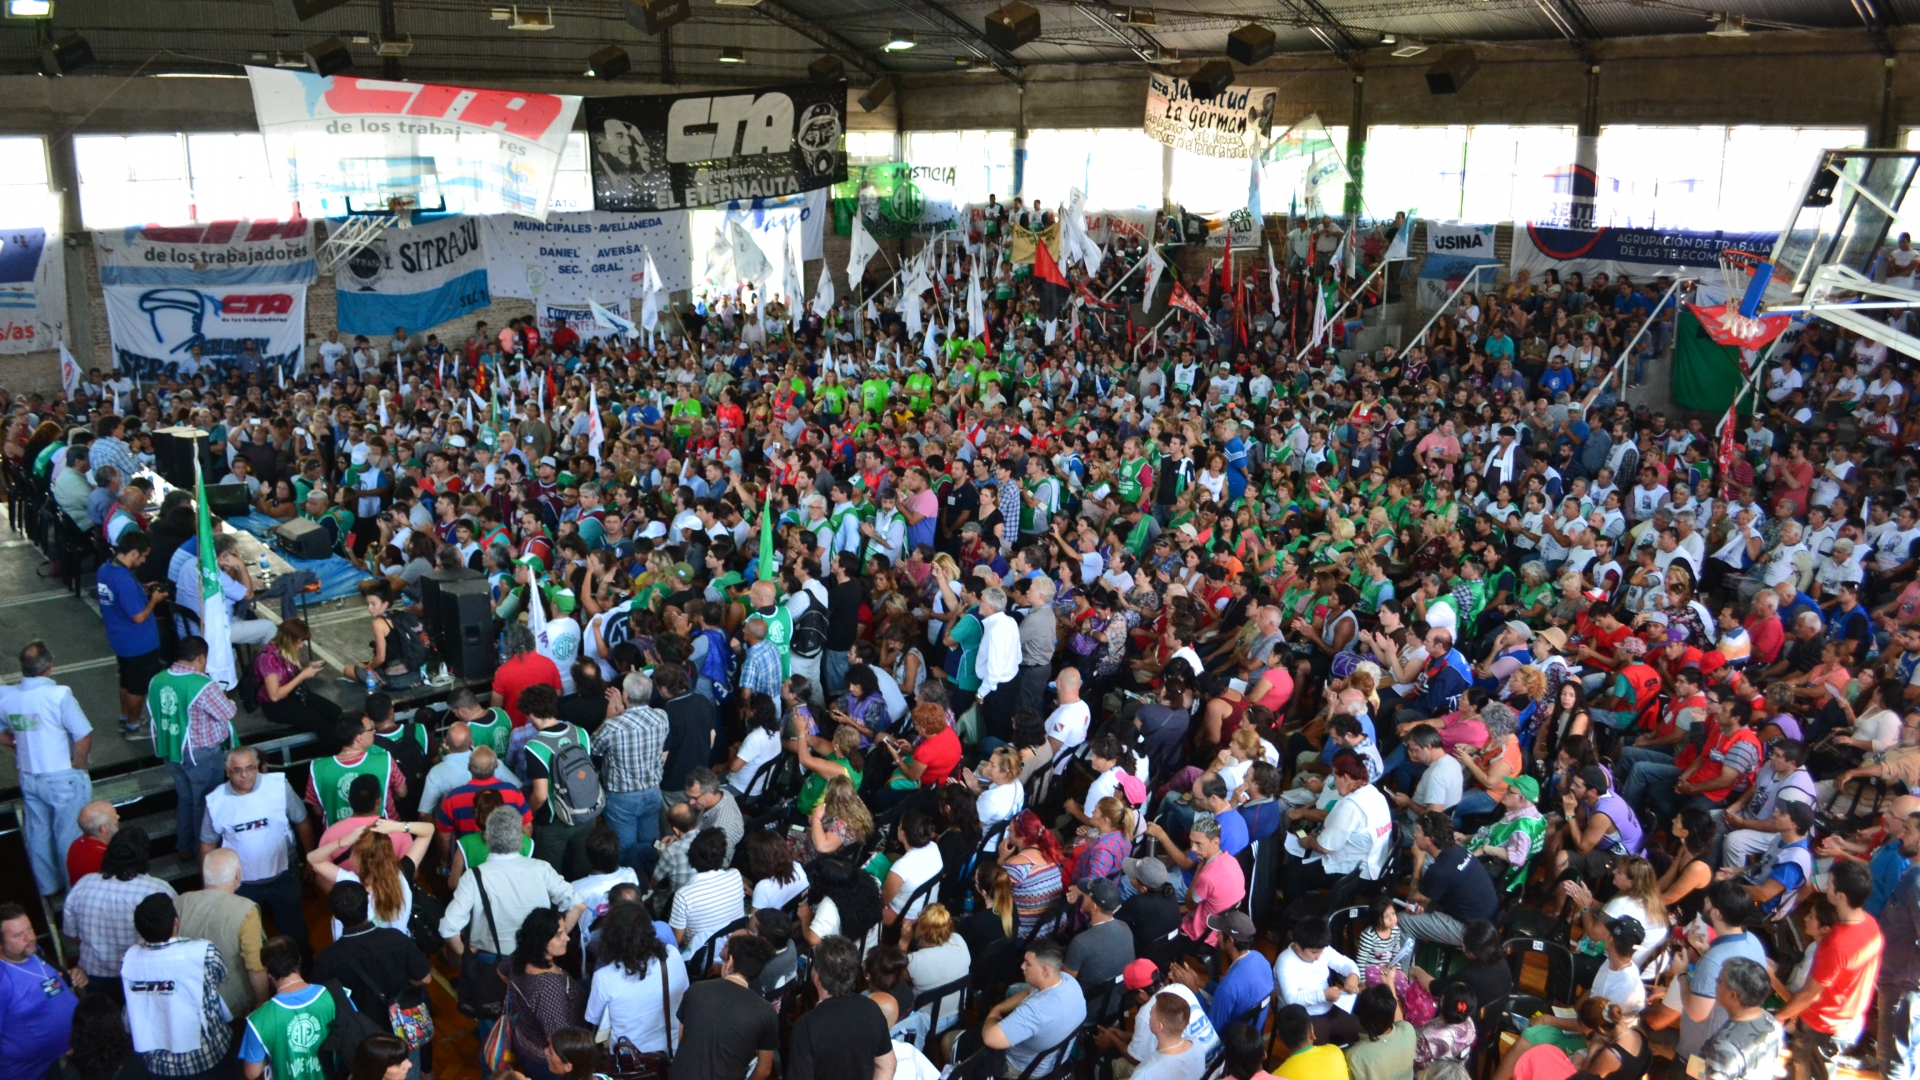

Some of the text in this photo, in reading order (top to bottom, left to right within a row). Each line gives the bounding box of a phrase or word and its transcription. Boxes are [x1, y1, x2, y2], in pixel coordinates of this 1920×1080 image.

[324, 76, 562, 141] CTA
[1166, 99, 1182, 122] La
[326, 120, 353, 135] de
[360, 118, 391, 134] los
[666, 92, 794, 163] CTA
[694, 165, 756, 182] Agrupación
[893, 166, 956, 186] JUSTICIA
[656, 175, 800, 209] EL ETERNAUTA
[513, 217, 662, 234] MUNICIPALES AVELLANEDA
[400, 216, 479, 274] SITRAJU
[1435, 234, 1483, 249] USINA
[1617, 233, 1776, 254] AGRUPACIÓN DE TRABAJA
[144, 244, 308, 266] de los trabajadores
[539, 244, 642, 259] DANIEL AVERSA
[1620, 245, 1635, 257] DE
[1638, 246, 1660, 259] LAS
[558, 263, 624, 274] SEC. GRAL.
[221, 293, 294, 315] CTA
[459, 291, 478, 308] SEC
[232, 817, 268, 833] CTA
[130, 980, 175, 992] CTA
